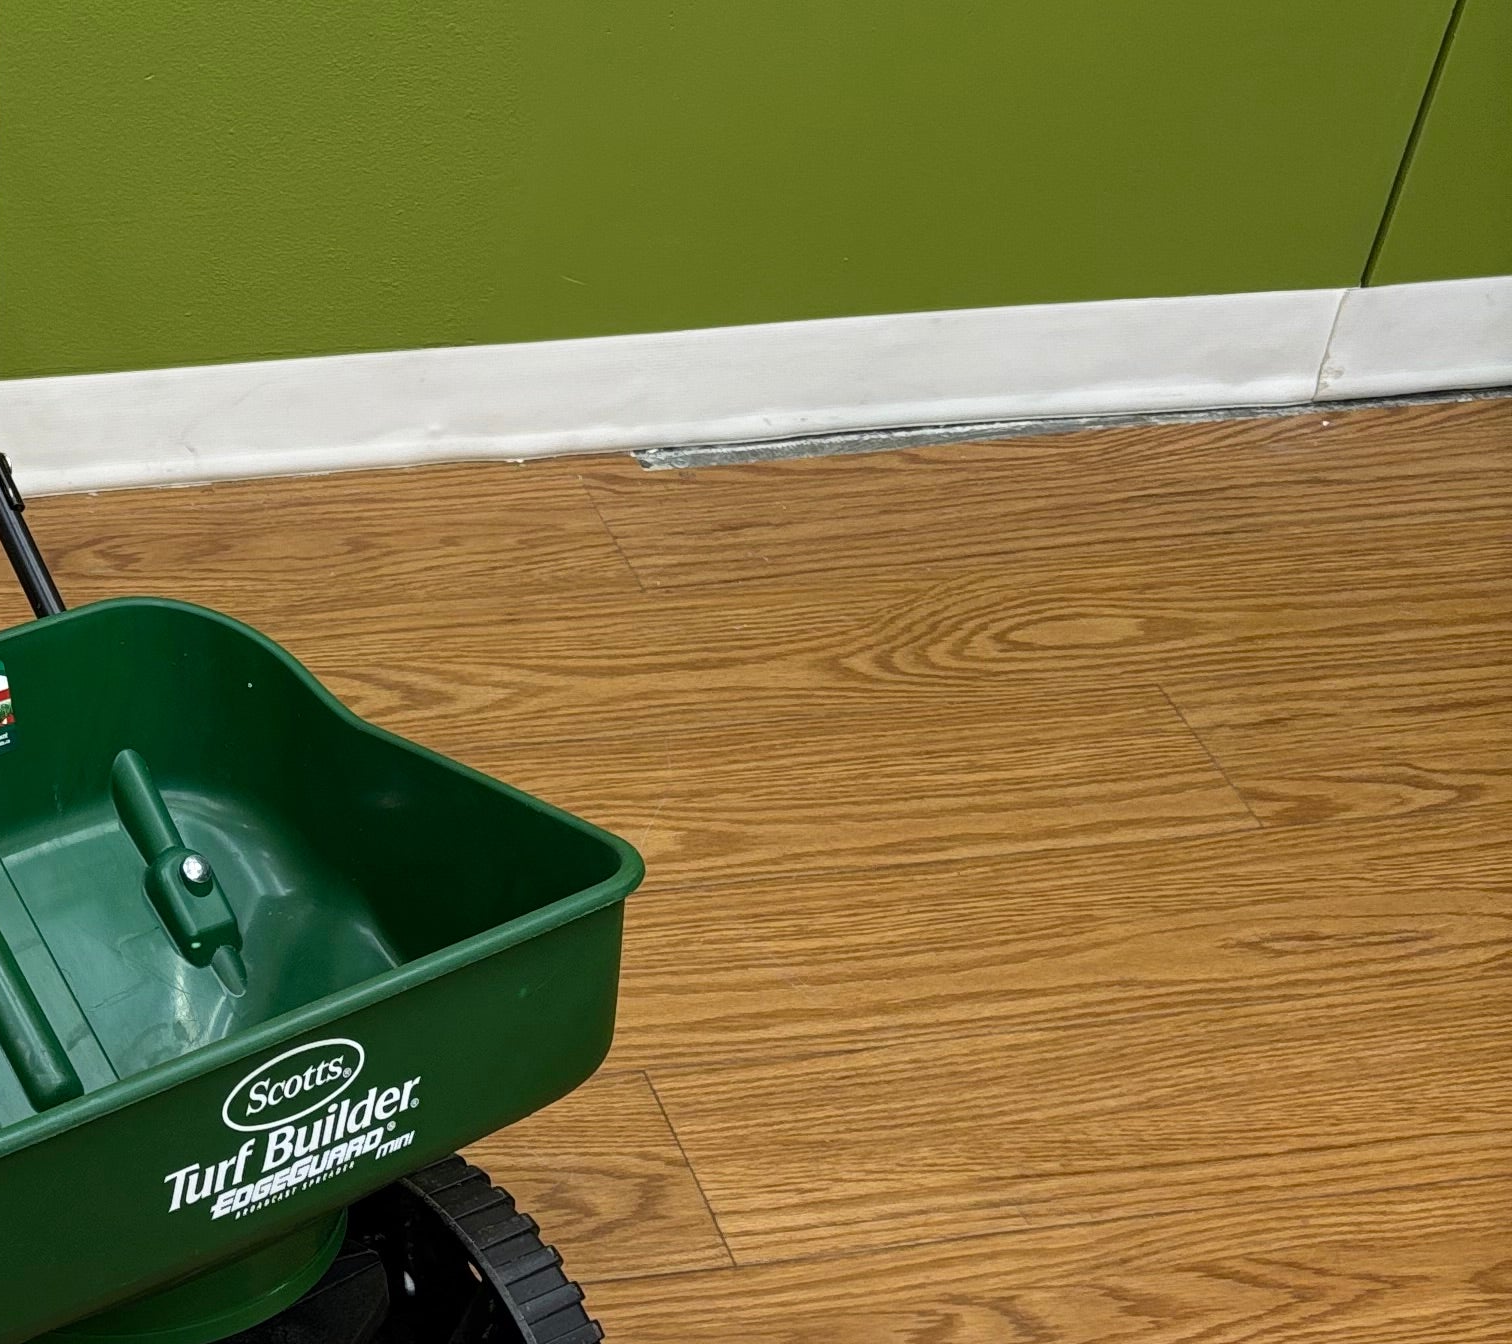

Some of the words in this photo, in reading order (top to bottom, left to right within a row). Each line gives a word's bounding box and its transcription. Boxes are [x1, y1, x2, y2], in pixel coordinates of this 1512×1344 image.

[245, 1055, 344, 1117] Scotts
[163, 1137, 256, 1213] Turf
[260, 1076, 421, 1173] Builder
[234, 1186, 298, 1220] BROADCAST
[301, 1160, 355, 1192] SPREADER
